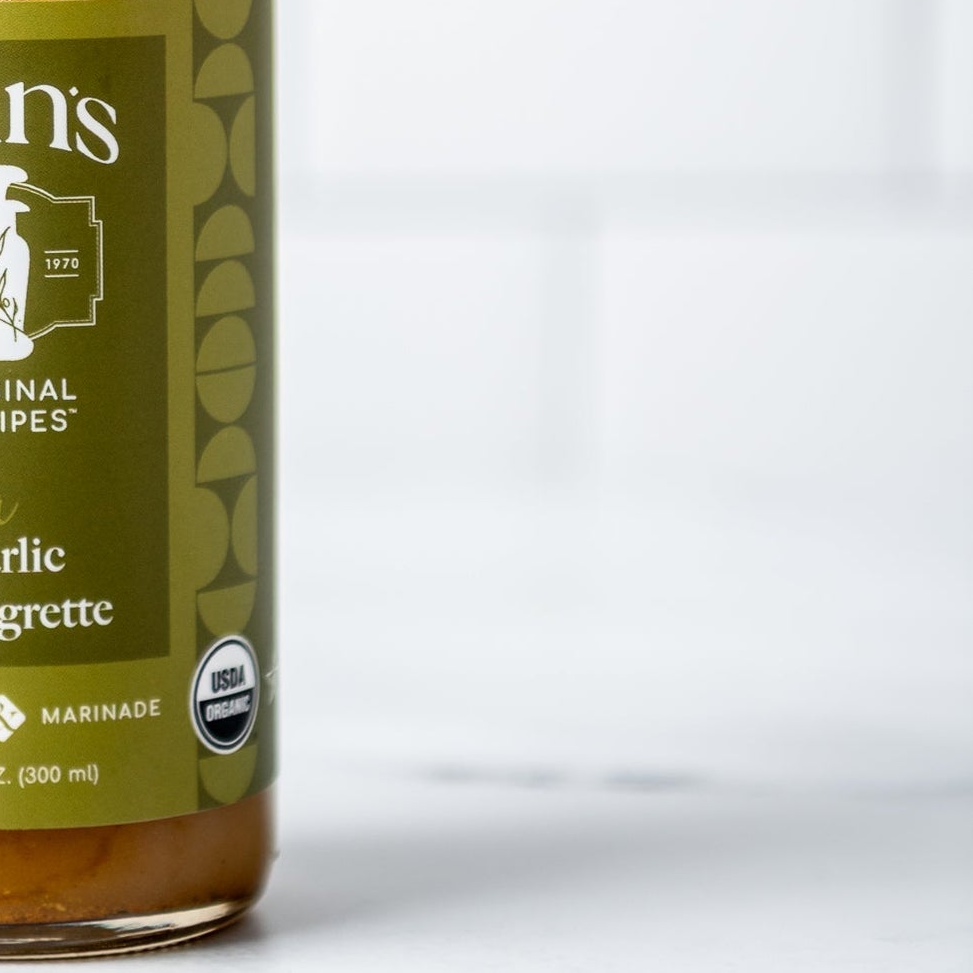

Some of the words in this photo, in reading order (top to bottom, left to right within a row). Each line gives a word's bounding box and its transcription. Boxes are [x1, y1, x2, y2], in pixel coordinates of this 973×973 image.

[45, 257, 80, 270] 1970
[210, 665, 246, 694] USDA
[42, 699, 161, 724] MARINADE
[206, 695, 251, 723] ORGANIC
[18, 765, 62, 789] (300
[69, 763, 100, 786] ml)
